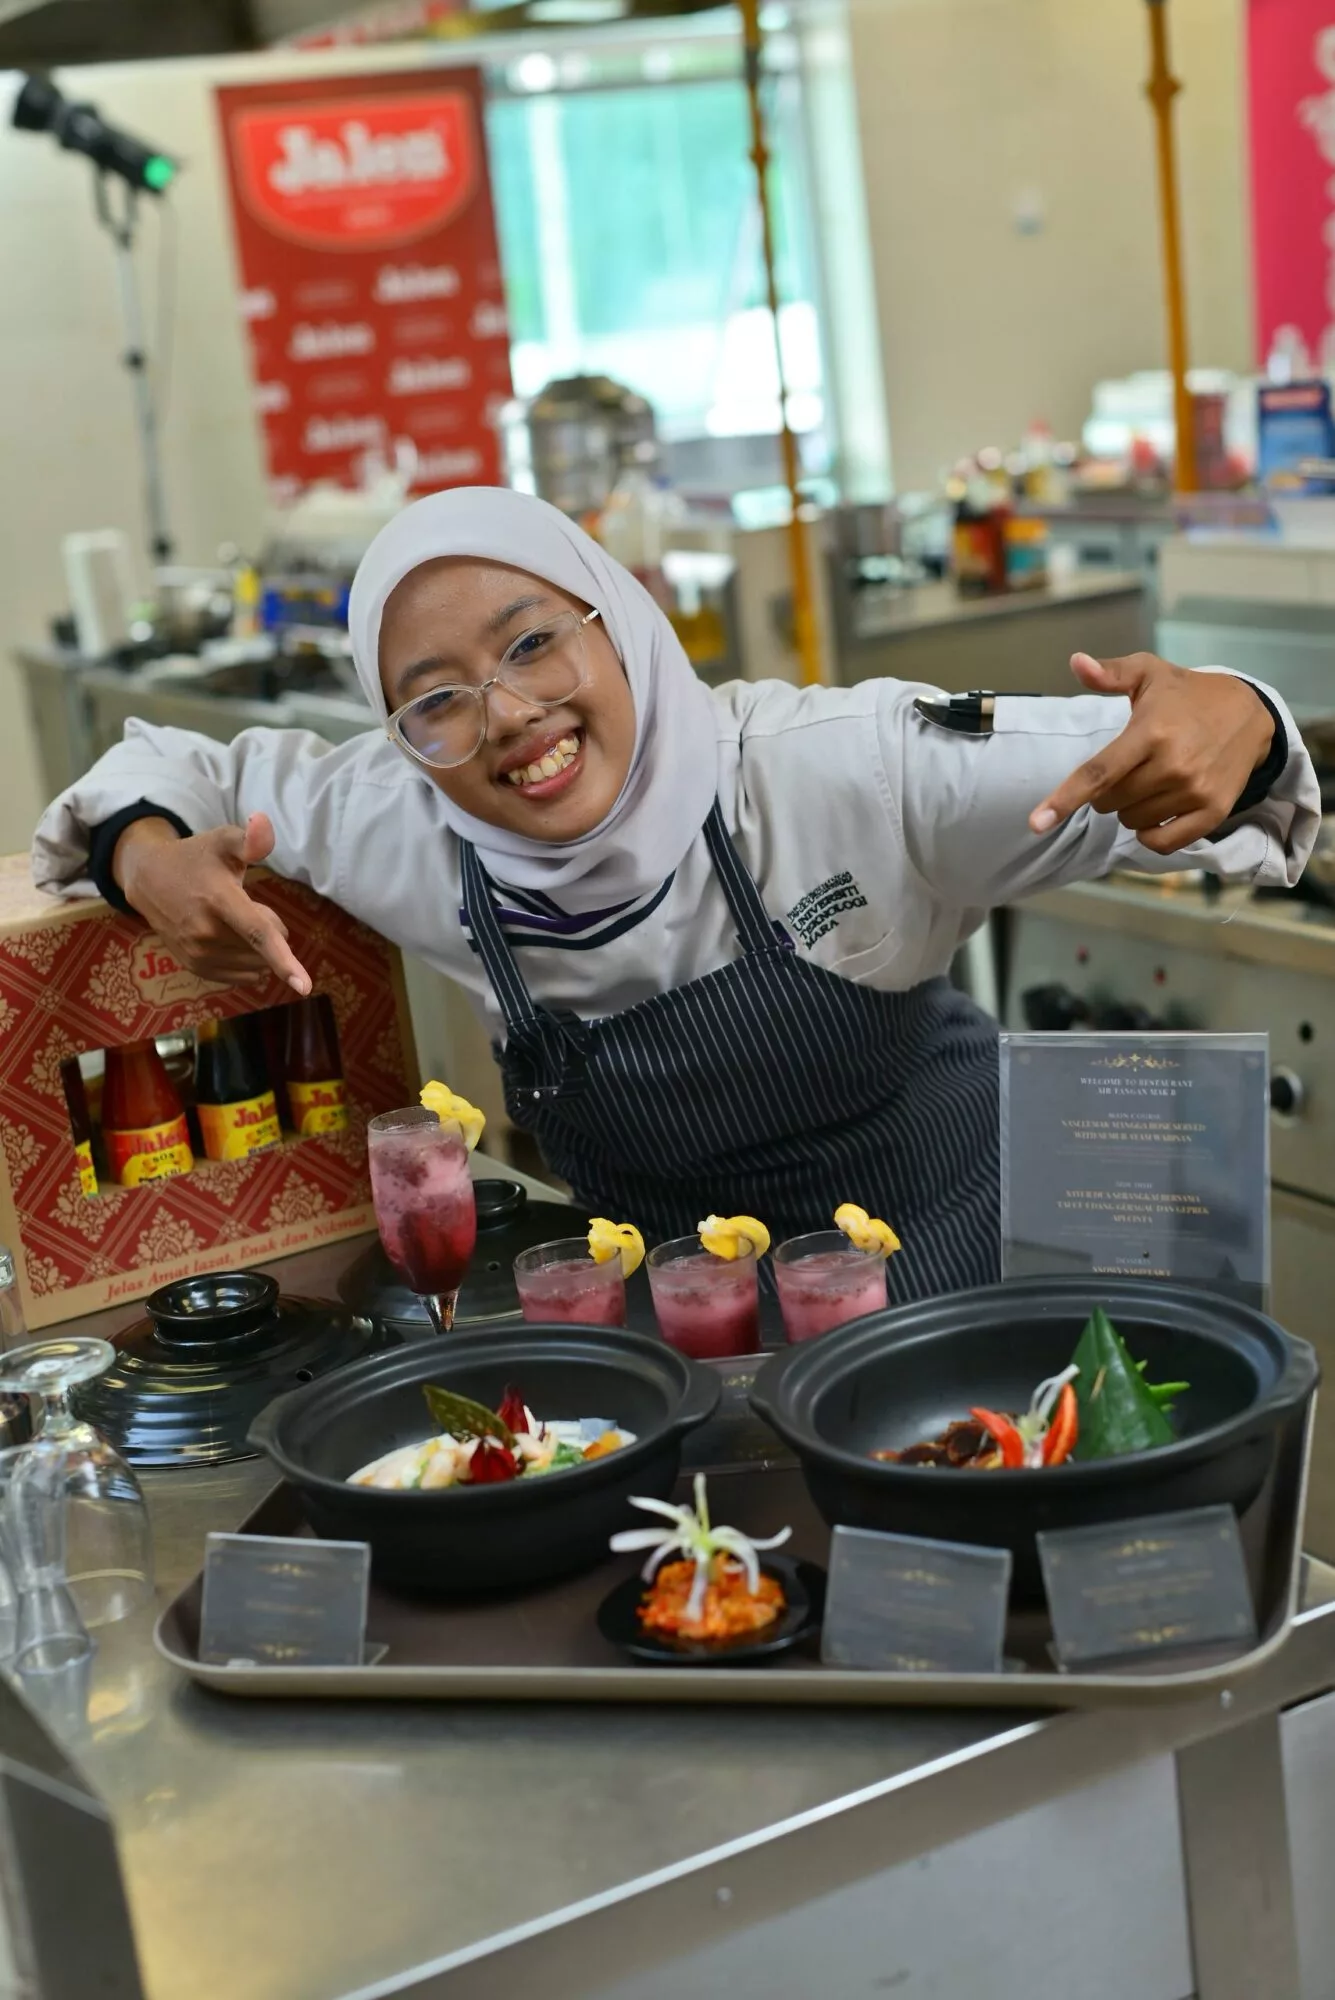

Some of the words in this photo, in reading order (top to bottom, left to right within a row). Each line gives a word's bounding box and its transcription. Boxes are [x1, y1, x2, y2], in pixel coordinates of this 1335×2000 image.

[793, 885, 859, 931] UNIVERSITI
[800, 895, 868, 939] TEKNOLOGI
[803, 919, 839, 950] MARA
[1080, 1077, 1121, 1085] WELCOME
[1125, 1078, 1136, 1086] TO
